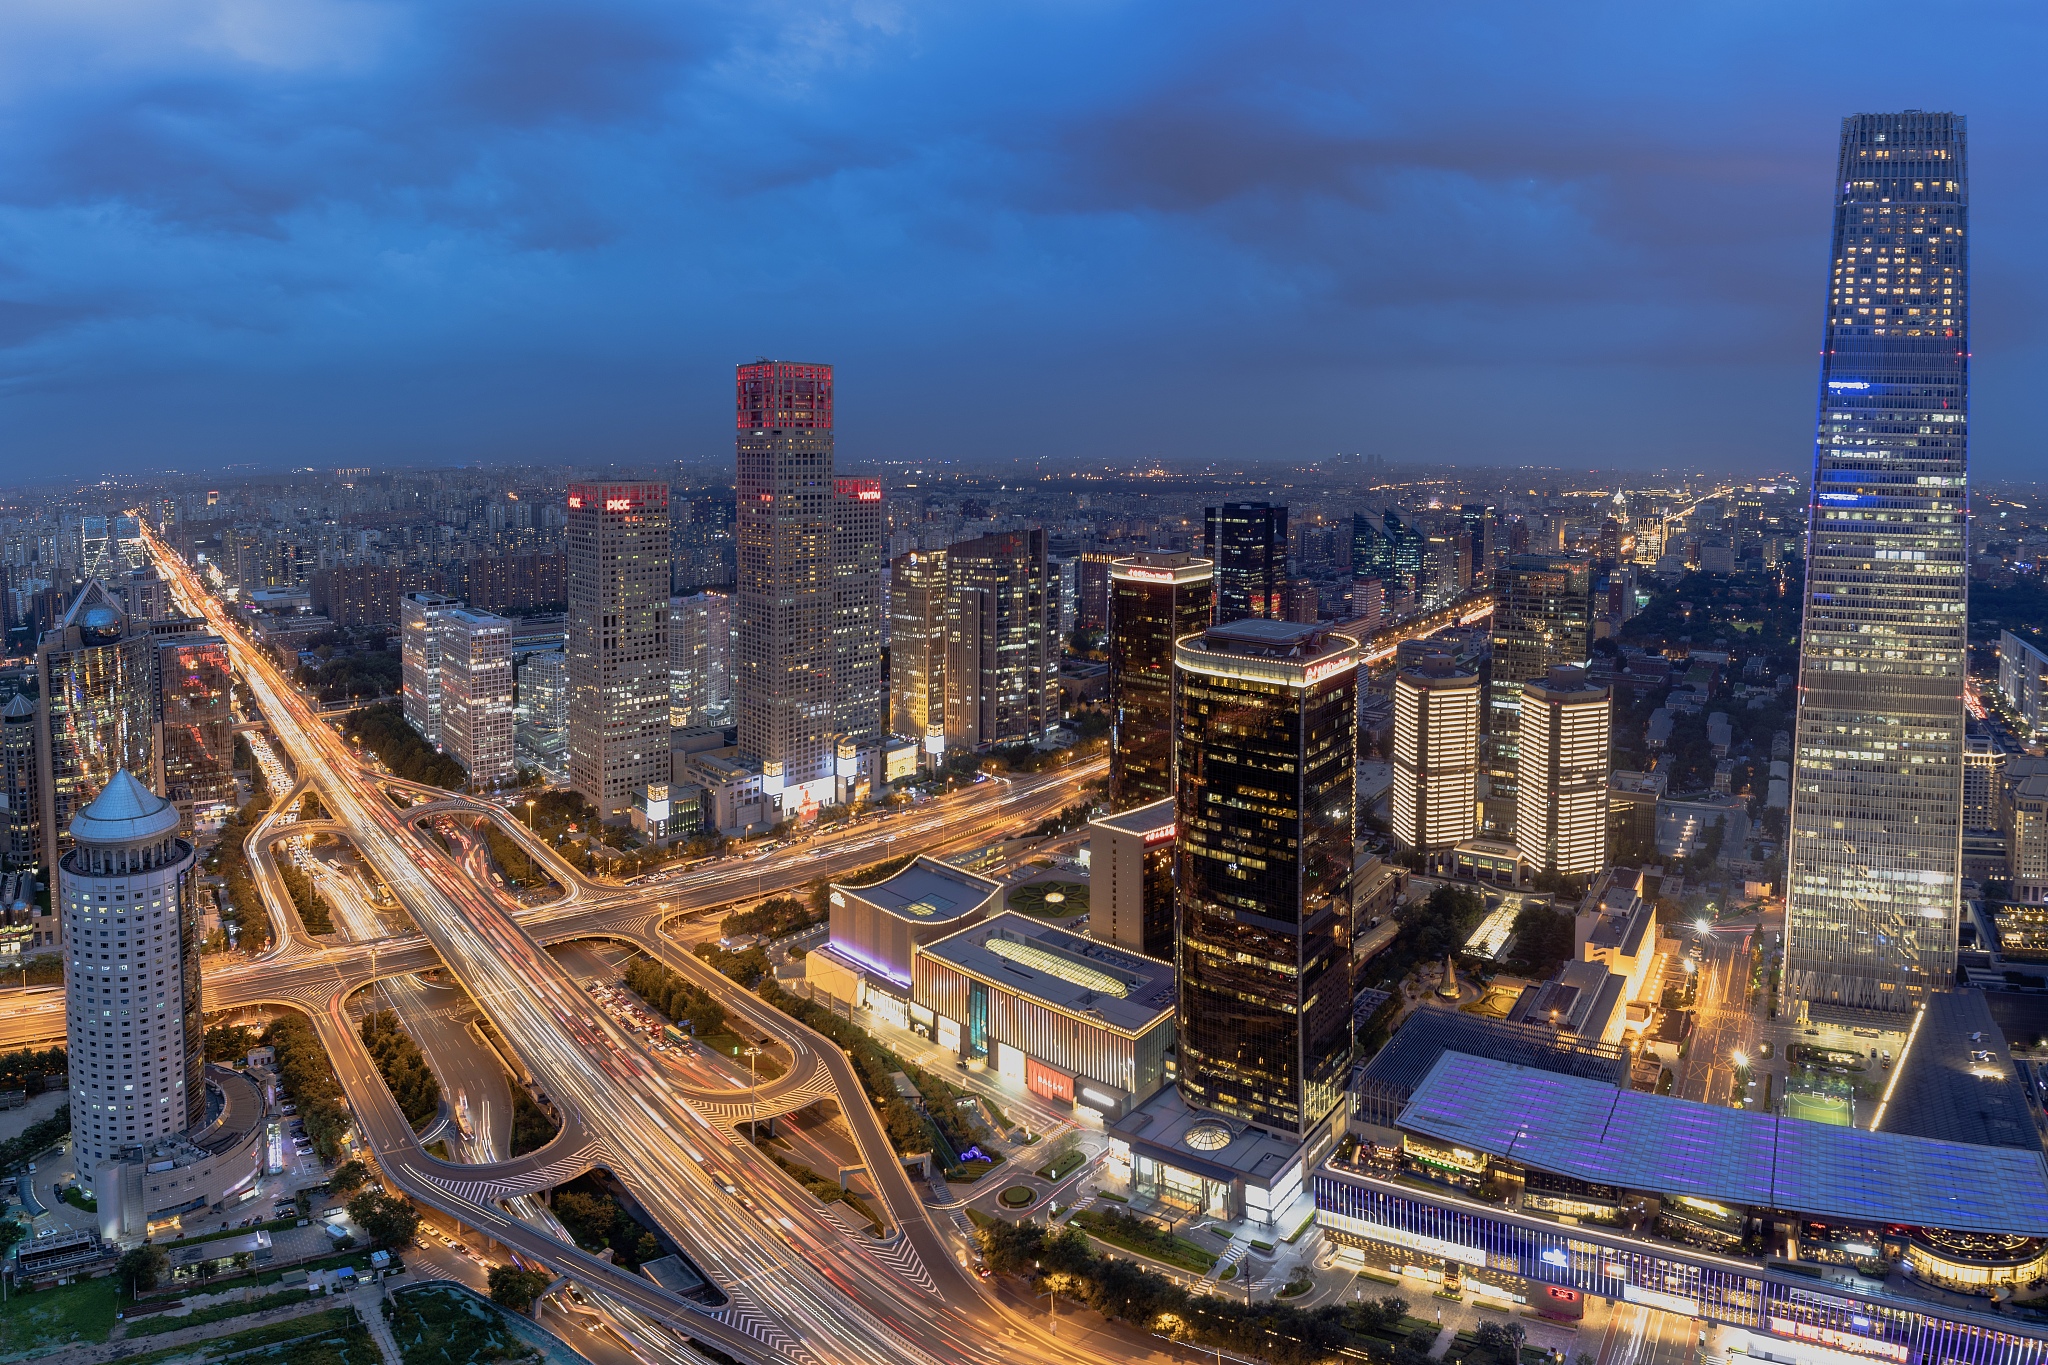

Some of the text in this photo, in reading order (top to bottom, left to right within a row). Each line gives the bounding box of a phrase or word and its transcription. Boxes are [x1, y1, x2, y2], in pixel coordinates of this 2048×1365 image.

[569, 497, 581, 508] PICC
[606, 499, 630, 511] PICC
[1037, 1075, 1064, 1092] BALLY
